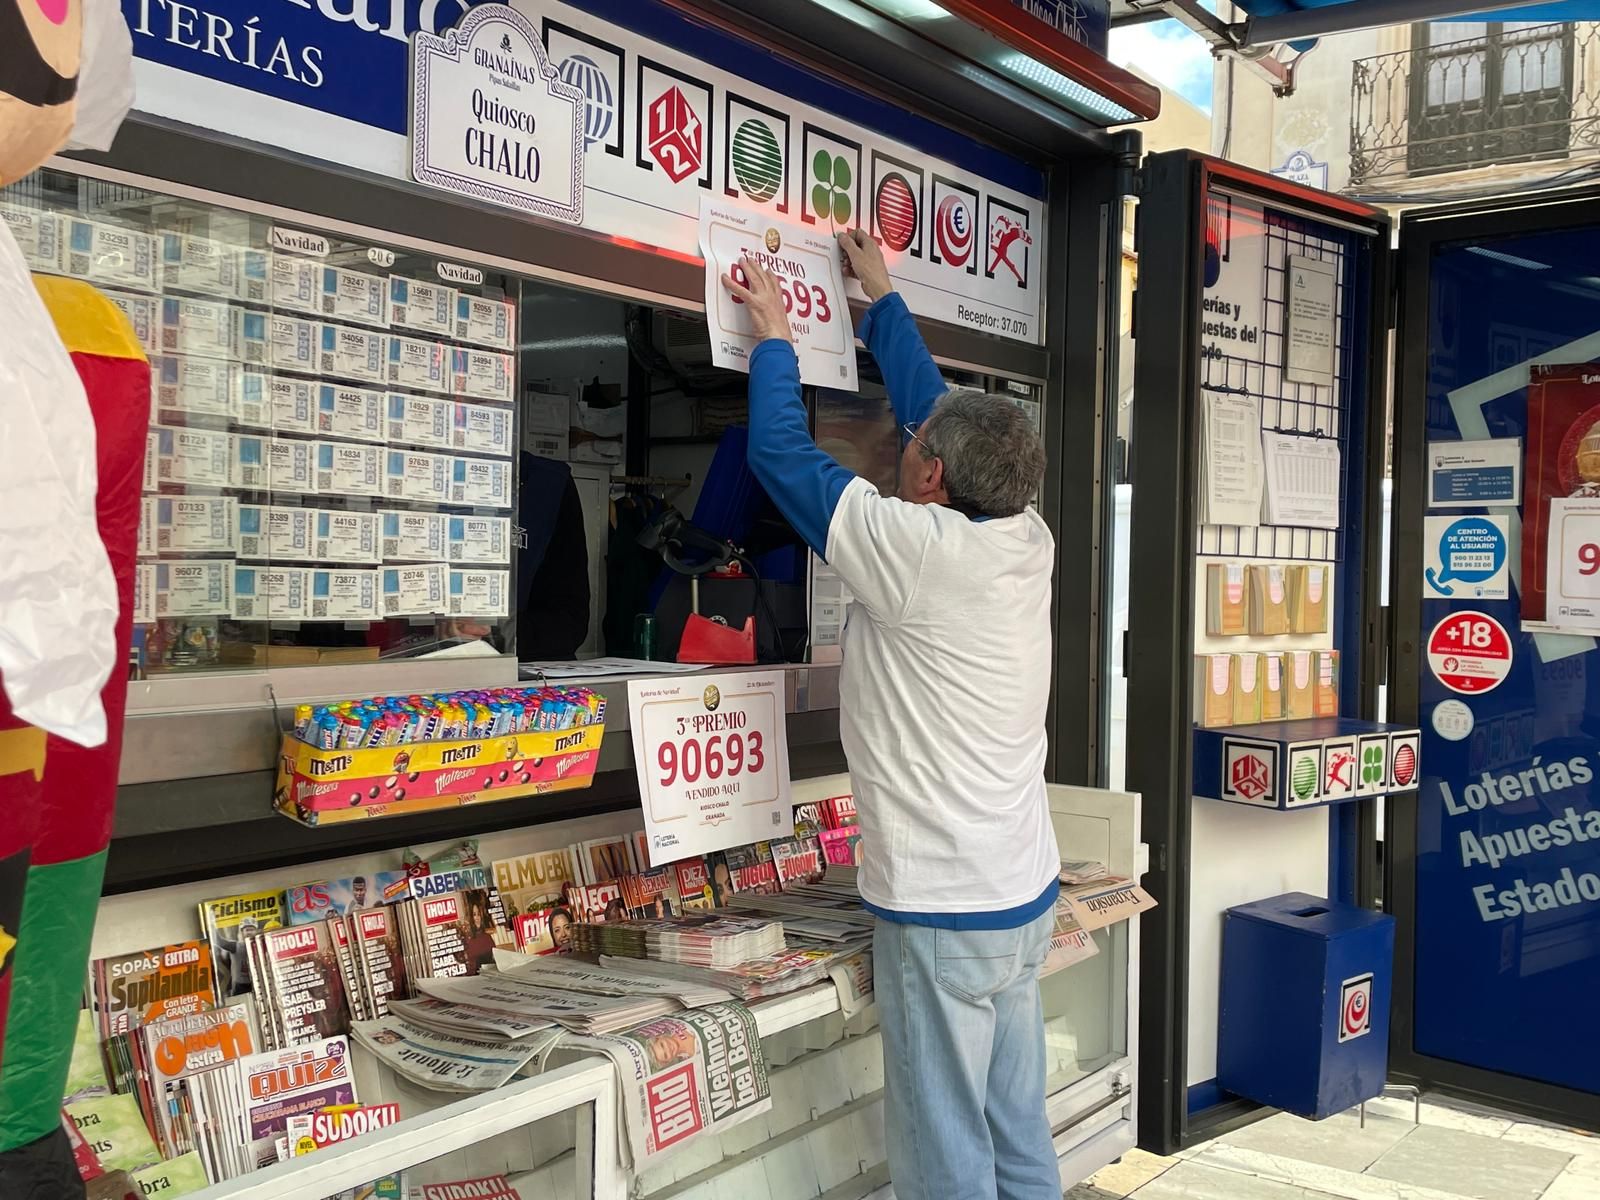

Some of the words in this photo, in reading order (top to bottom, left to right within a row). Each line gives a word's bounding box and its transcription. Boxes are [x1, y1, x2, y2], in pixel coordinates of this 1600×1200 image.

[474, 48, 536, 84] GRANAÍNAS
[472, 88, 536, 135] Quiosco
[465, 127, 541, 183] CHALO
[99, 231, 129, 246] 93293
[274, 231, 325, 253] Navidad
[371, 250, 384, 262] 20
[384, 251, 393, 264] €
[755, 252, 806, 279] PREMIO
[440, 264, 482, 283] Navidad
[731, 263, 832, 323] 9693
[957, 304, 999, 329] Receptor:
[1001, 316, 1028, 336] 37.070
[1234, 303, 1241, 321] y
[1241, 325, 1257, 344] del
[1447, 535, 1459, 543] DE
[1460, 534, 1498, 543] ATENCIÓN
[1457, 528, 1488, 536] CENTRO
[1461, 542, 1495, 550] USUARIO
[175, 567, 203, 576] 96072
[1446, 620, 1492, 648] +18
[692, 711, 747, 733] PREMIO
[556, 752, 590, 778] Maltesers
[658, 730, 764, 787] 90693
[296, 780, 340, 801] Maltesers
[435, 767, 476, 795] Maltesers
[1440, 756, 1593, 816] Loterías
[685, 786, 720, 800] VENDIDO
[495, 862, 519, 893] EL
[682, 866, 704, 881] DIEZ
[292, 884, 330, 913] as
[1086, 889, 1141, 916] Expansión
[1473, 867, 1600, 922] Estado
[210, 896, 276, 918] Ciclismo
[426, 899, 456, 919] ¡HOLA!
[273, 930, 315, 951] ¡HOLA!
[112, 955, 160, 977] SOPAS
[164, 948, 200, 967] EXTRA
[432, 954, 457, 970] ISABEL
[110, 965, 210, 1013] Sopilandia
[281, 990, 313, 1008] ISABEL
[163, 998, 179, 1010] Con
[180, 994, 199, 1006] letra
[165, 1003, 198, 1018] GRANDE
[284, 999, 327, 1020] PREYSLER
[398, 1048, 458, 1076] Monde
[457, 1065, 480, 1079] Le
[732, 1066, 756, 1108] bei
[651, 1070, 696, 1144] Bild
[315, 1106, 396, 1145] SUDOKU
[138, 1175, 171, 1196] bra
